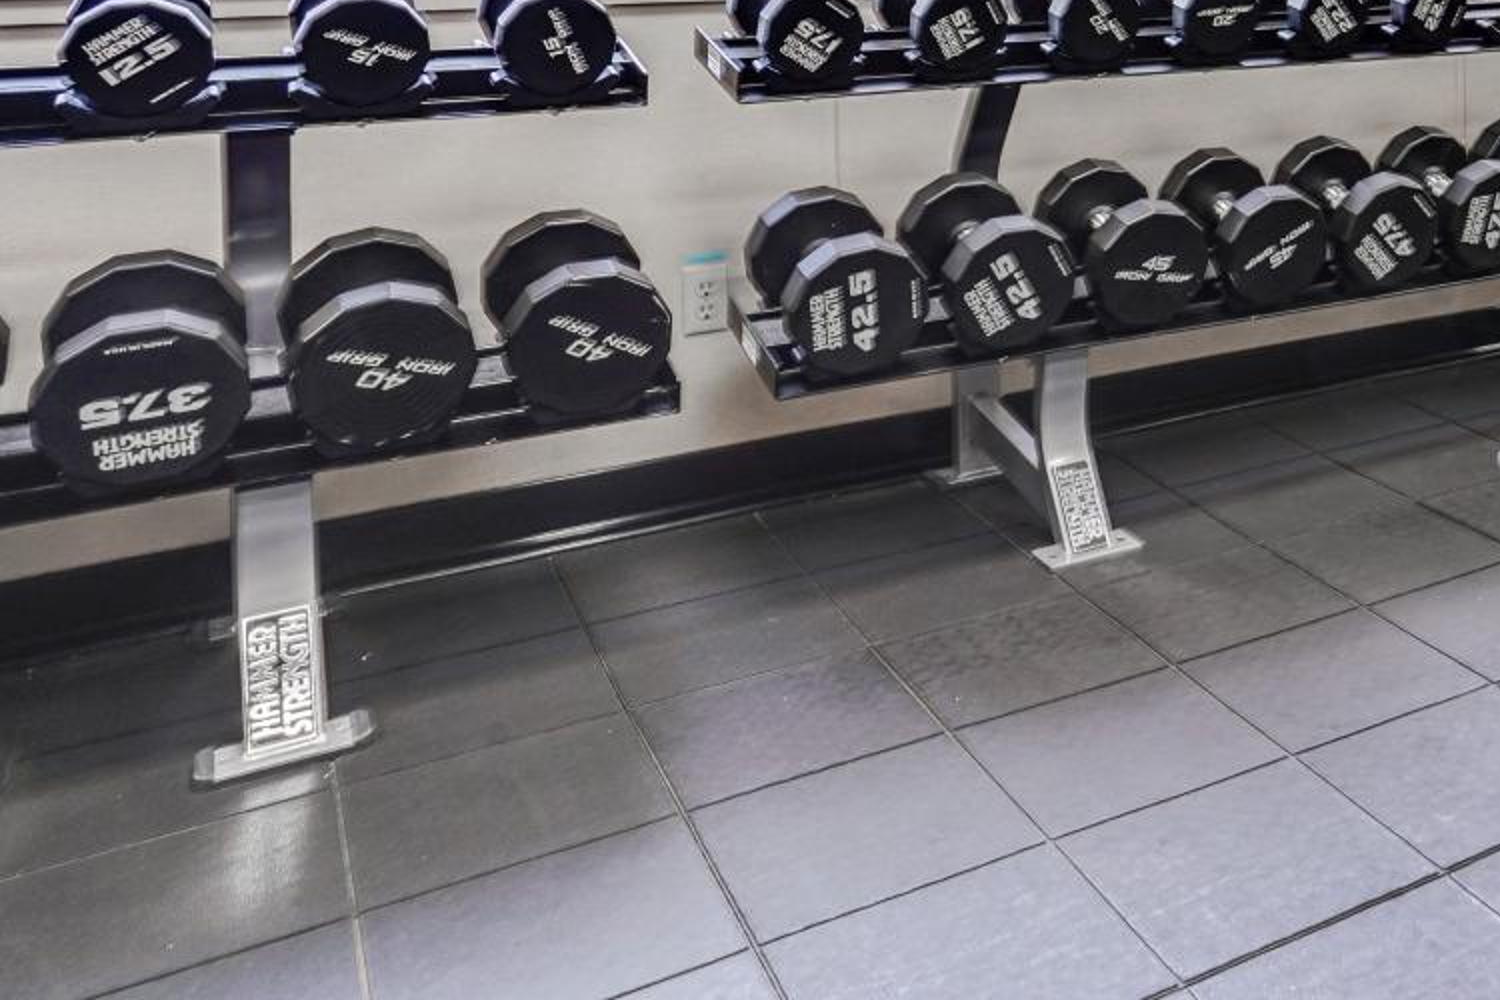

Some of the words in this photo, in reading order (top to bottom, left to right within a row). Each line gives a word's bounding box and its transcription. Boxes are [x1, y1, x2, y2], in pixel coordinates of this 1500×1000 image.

[81, 15, 148, 57] HAMMER
[89, 22, 161, 66] STRENGTH
[543, 37, 567, 59] 15
[793, 18, 842, 56] 17.5
[950, 8, 984, 51] 17.5
[98, 32, 182, 87] 12.5
[346, 47, 380, 67] 15
[1373, 212, 1417, 256] 47.5
[1141, 253, 1177, 271] 45
[1270, 243, 1298, 270] 45
[973, 276, 1014, 331] STRENGTH
[989, 250, 1042, 319] 42.5
[809, 293, 829, 353] HAMMER
[822, 286, 848, 351] STRENGTH
[847, 267, 880, 353] 42.5
[963, 290, 997, 337] HAMMER
[394, 356, 457, 376] IRON
[565, 338, 614, 362] 40
[354, 366, 414, 391] 40
[78, 382, 213, 431] 37.5
[91, 418, 205, 457] STRENGTH
[99, 437, 200, 471] HAMMER
[249, 621, 284, 743] HAMMER
[276, 612, 314, 738] STRENGTH
